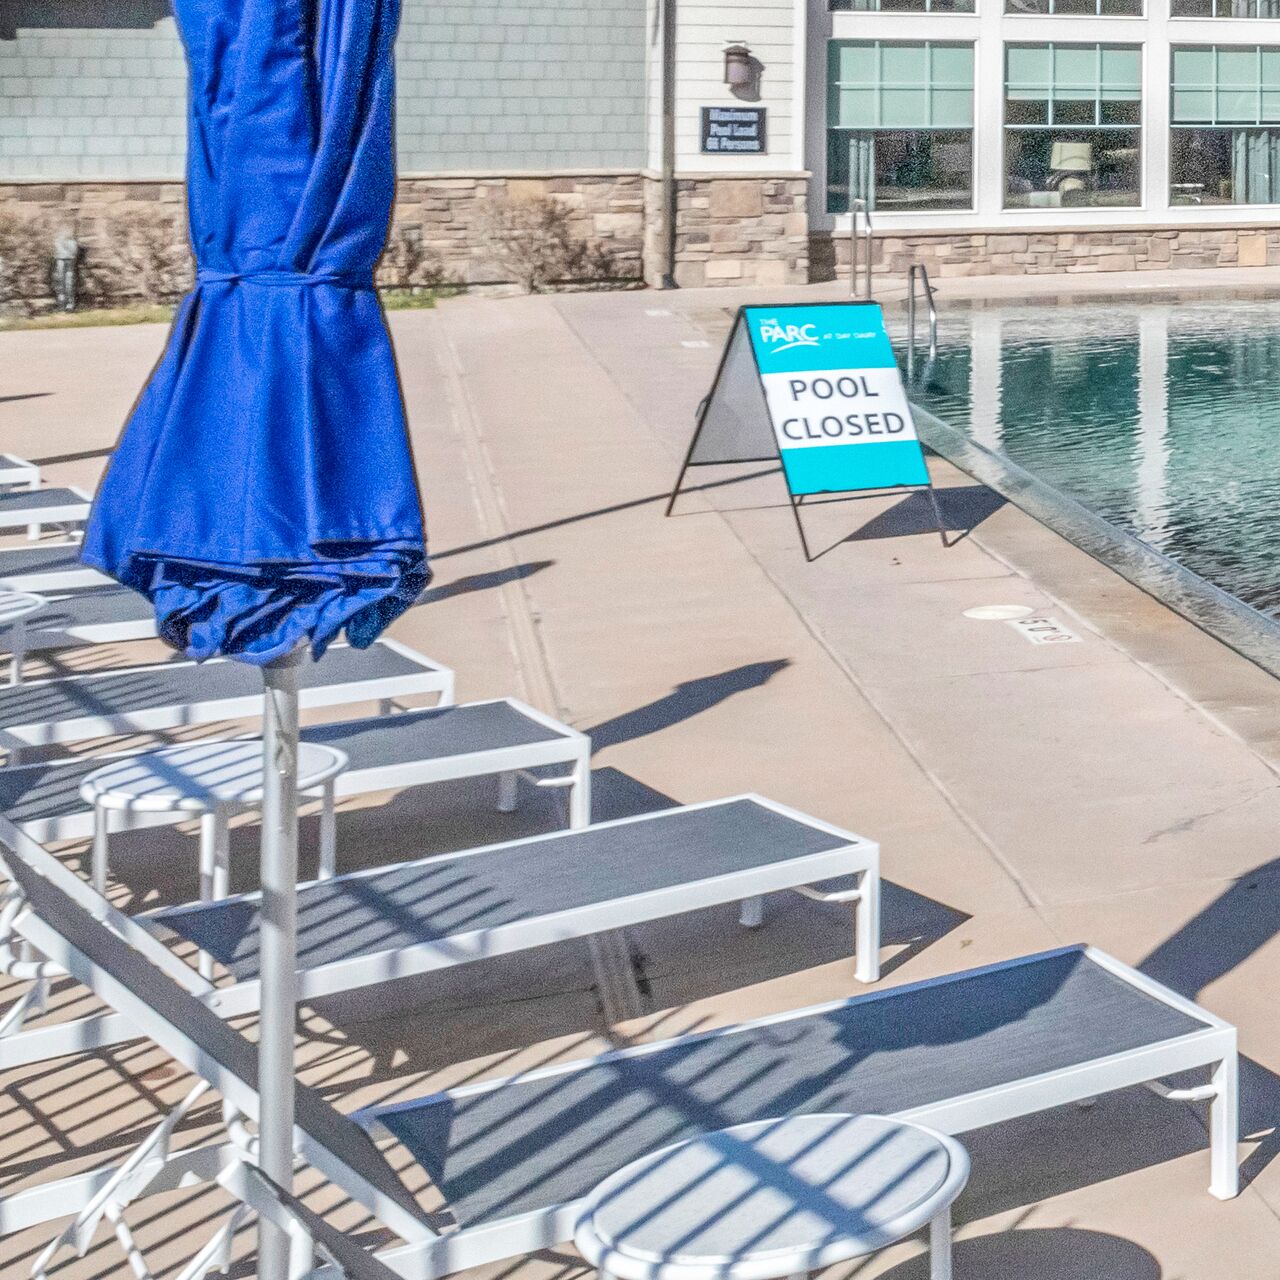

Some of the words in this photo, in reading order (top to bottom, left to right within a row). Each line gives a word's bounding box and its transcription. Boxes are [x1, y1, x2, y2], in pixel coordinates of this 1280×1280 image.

[760, 323, 819, 342] PARC
[789, 376, 878, 402] POOL
[782, 412, 905, 440] CLOSED
